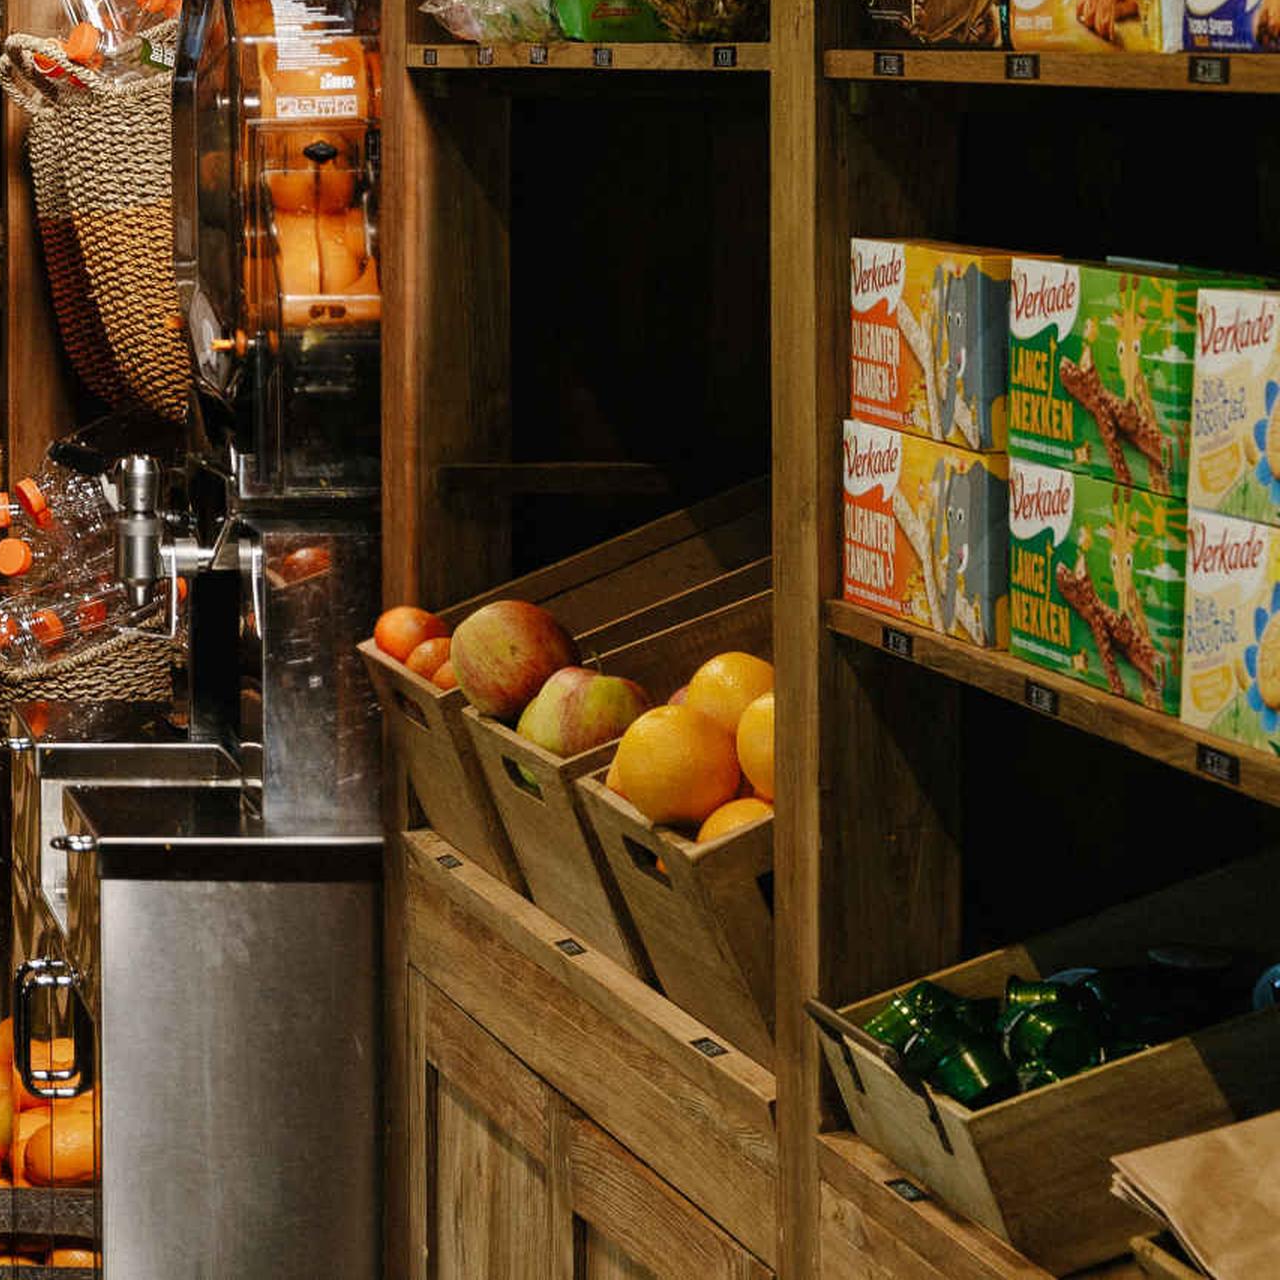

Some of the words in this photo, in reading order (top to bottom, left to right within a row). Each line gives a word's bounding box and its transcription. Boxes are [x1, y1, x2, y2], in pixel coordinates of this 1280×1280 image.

[851, 249, 903, 306] Verkade
[1010, 264, 1077, 322] Verkade
[1197, 291, 1274, 356] Verkade
[843, 431, 898, 480] Verkade
[1010, 468, 1071, 522] Verkade
[1187, 519, 1265, 575] Verkade
